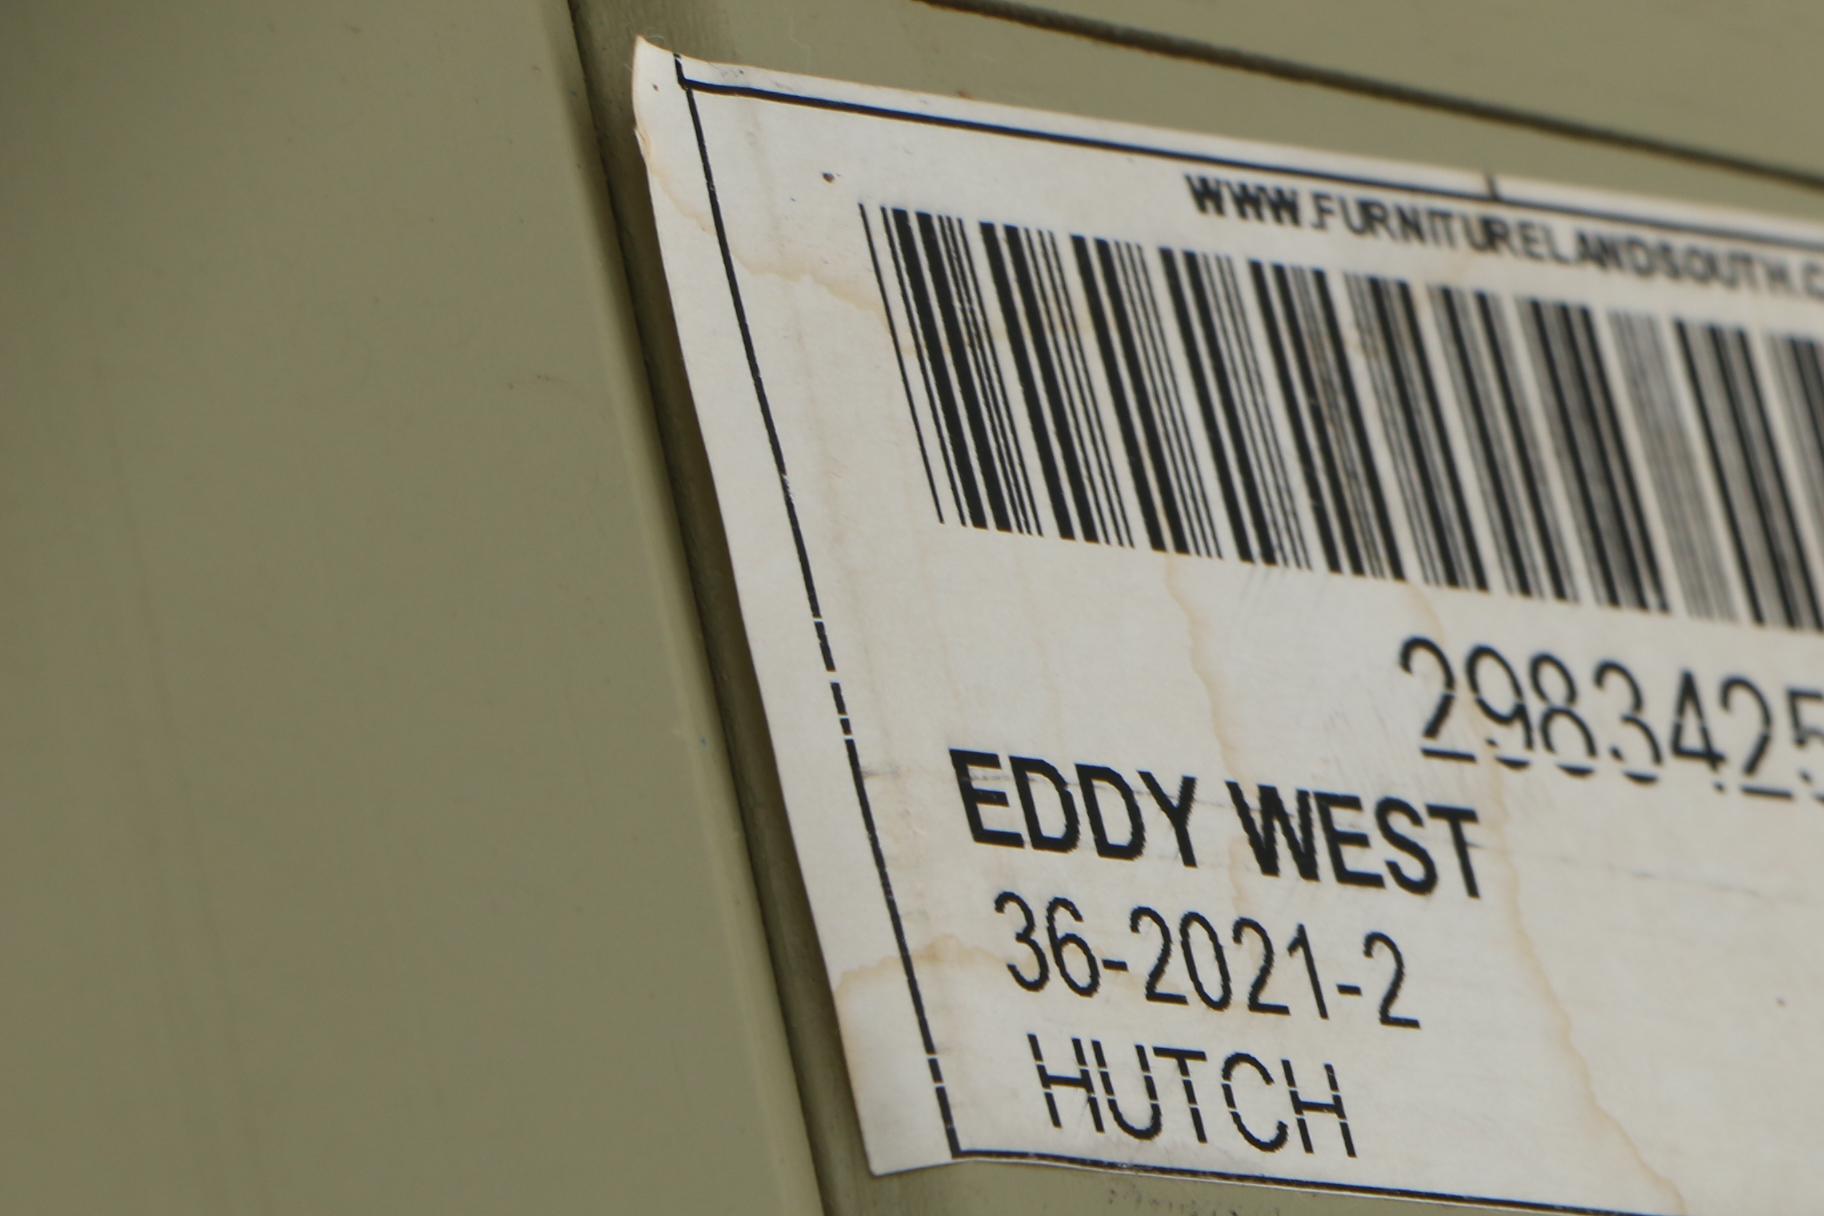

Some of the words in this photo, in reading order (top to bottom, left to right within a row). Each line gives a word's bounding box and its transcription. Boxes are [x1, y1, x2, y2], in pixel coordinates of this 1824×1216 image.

[948, 747, 1197, 869] EDDY
[1224, 779, 1483, 899] WEST
[993, 889, 1422, 1030] 36-2021-2
[1027, 1033, 1358, 1159] HUTCH
